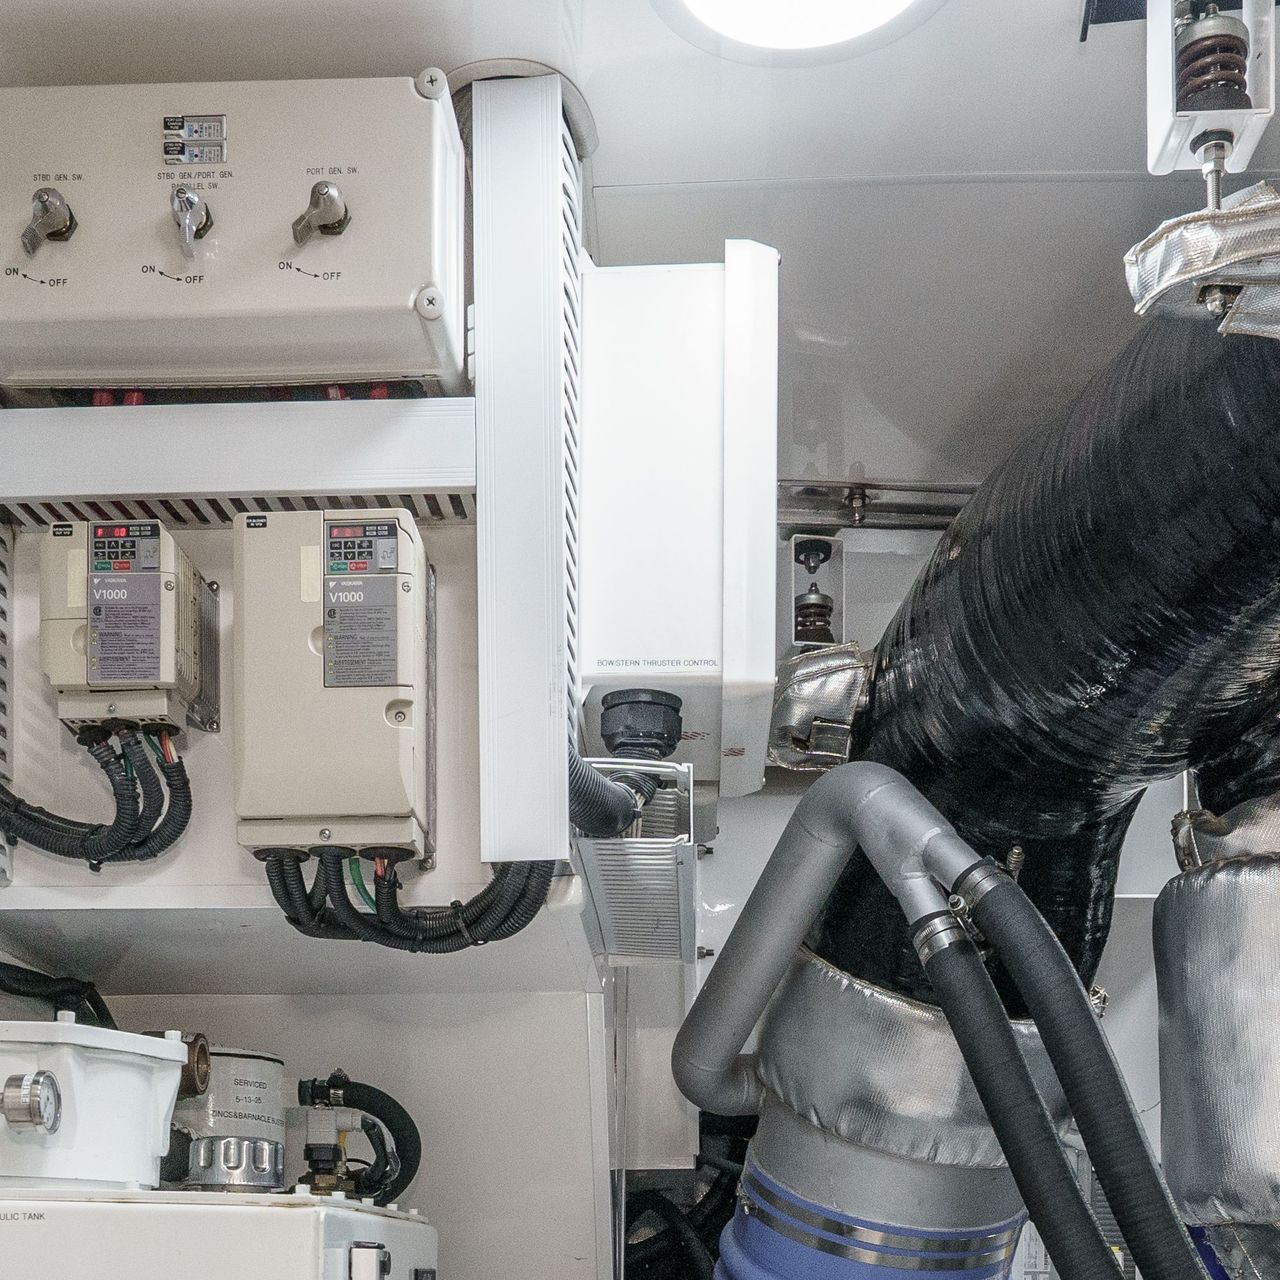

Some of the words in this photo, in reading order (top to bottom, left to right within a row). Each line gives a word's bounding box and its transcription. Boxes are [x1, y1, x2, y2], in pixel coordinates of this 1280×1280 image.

[157, 172, 175, 180] STBD
[142, 265, 155, 273] ON
[279, 262, 292, 270] ON
[5, 268, 19, 276] ON
[323, 272, 341, 280] OFF
[49, 279, 68, 287] OFF
[185, 276, 204, 284] OFF
[94, 590, 127, 599] V1000
[329, 592, 364, 602] V1000
[234, 1078, 267, 1089] SERVICED
[22, 1212, 45, 1220] TANK
